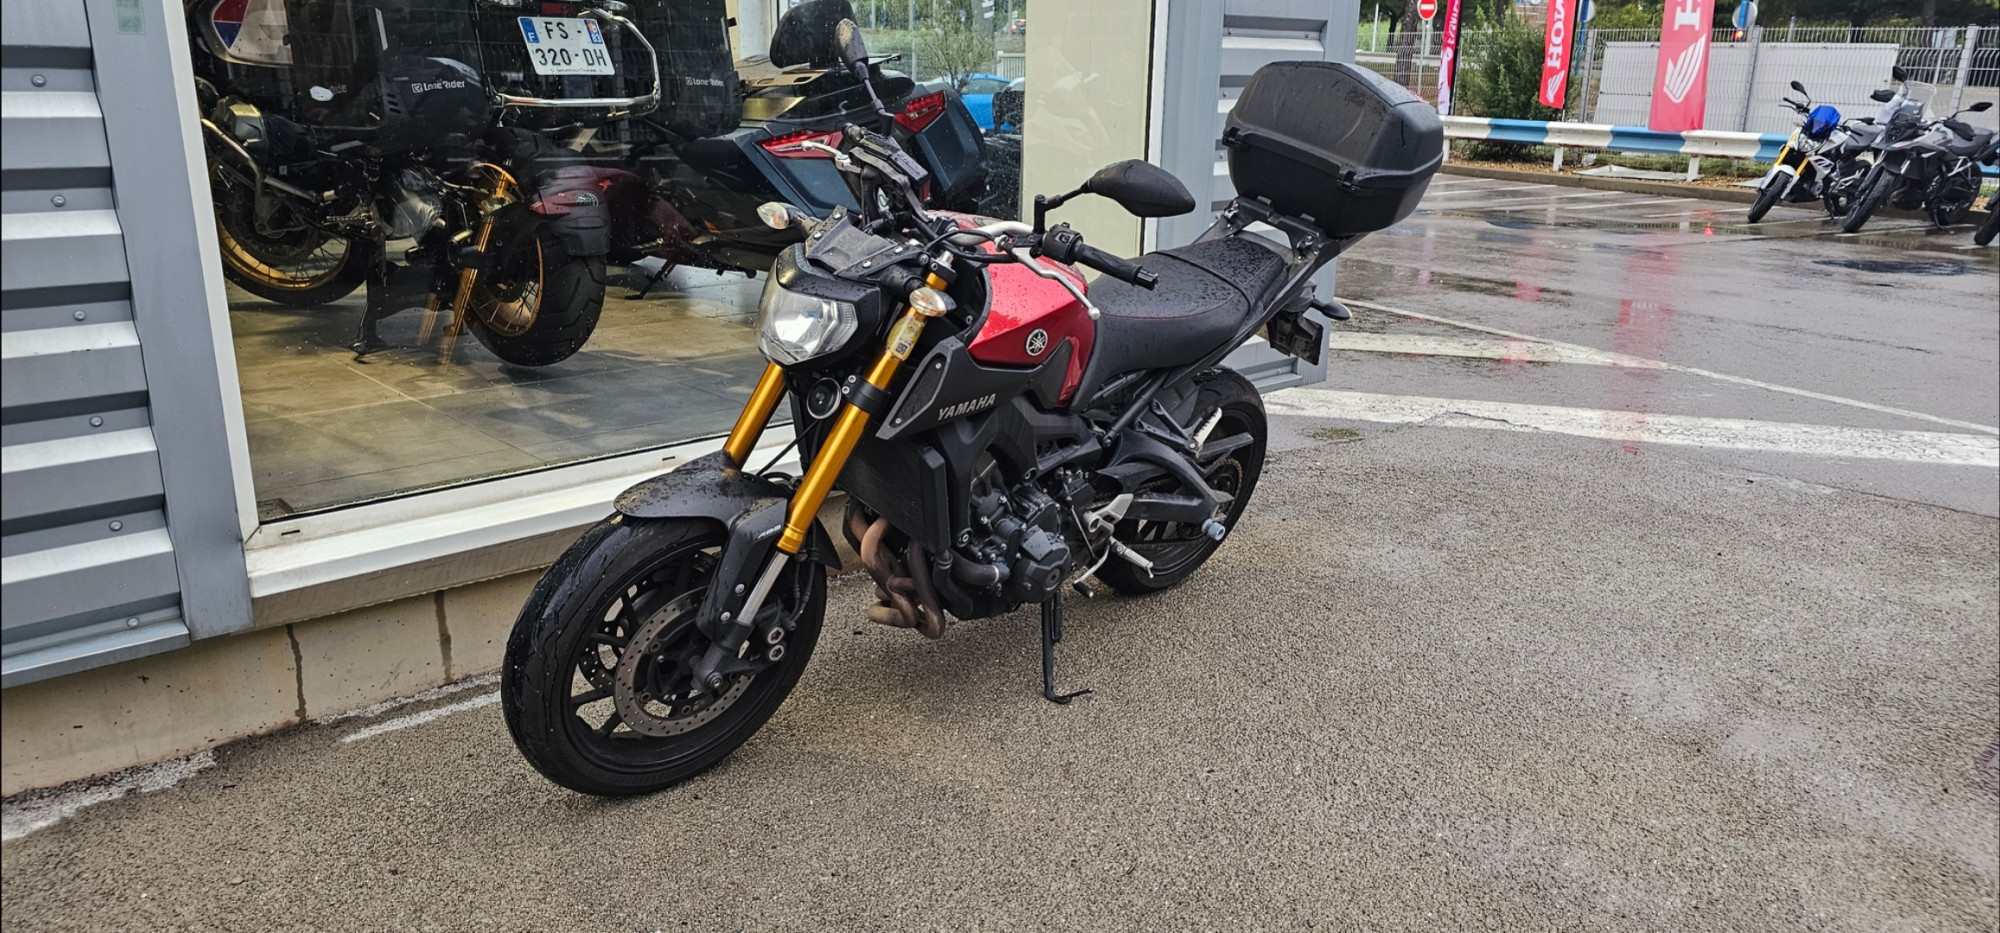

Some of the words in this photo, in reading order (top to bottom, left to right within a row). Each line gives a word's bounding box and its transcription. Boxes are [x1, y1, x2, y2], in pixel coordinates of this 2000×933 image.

[527, 32, 537, 42] F
[542, 21, 569, 40] FS
[937, 393, 997, 421] YAMAHA
